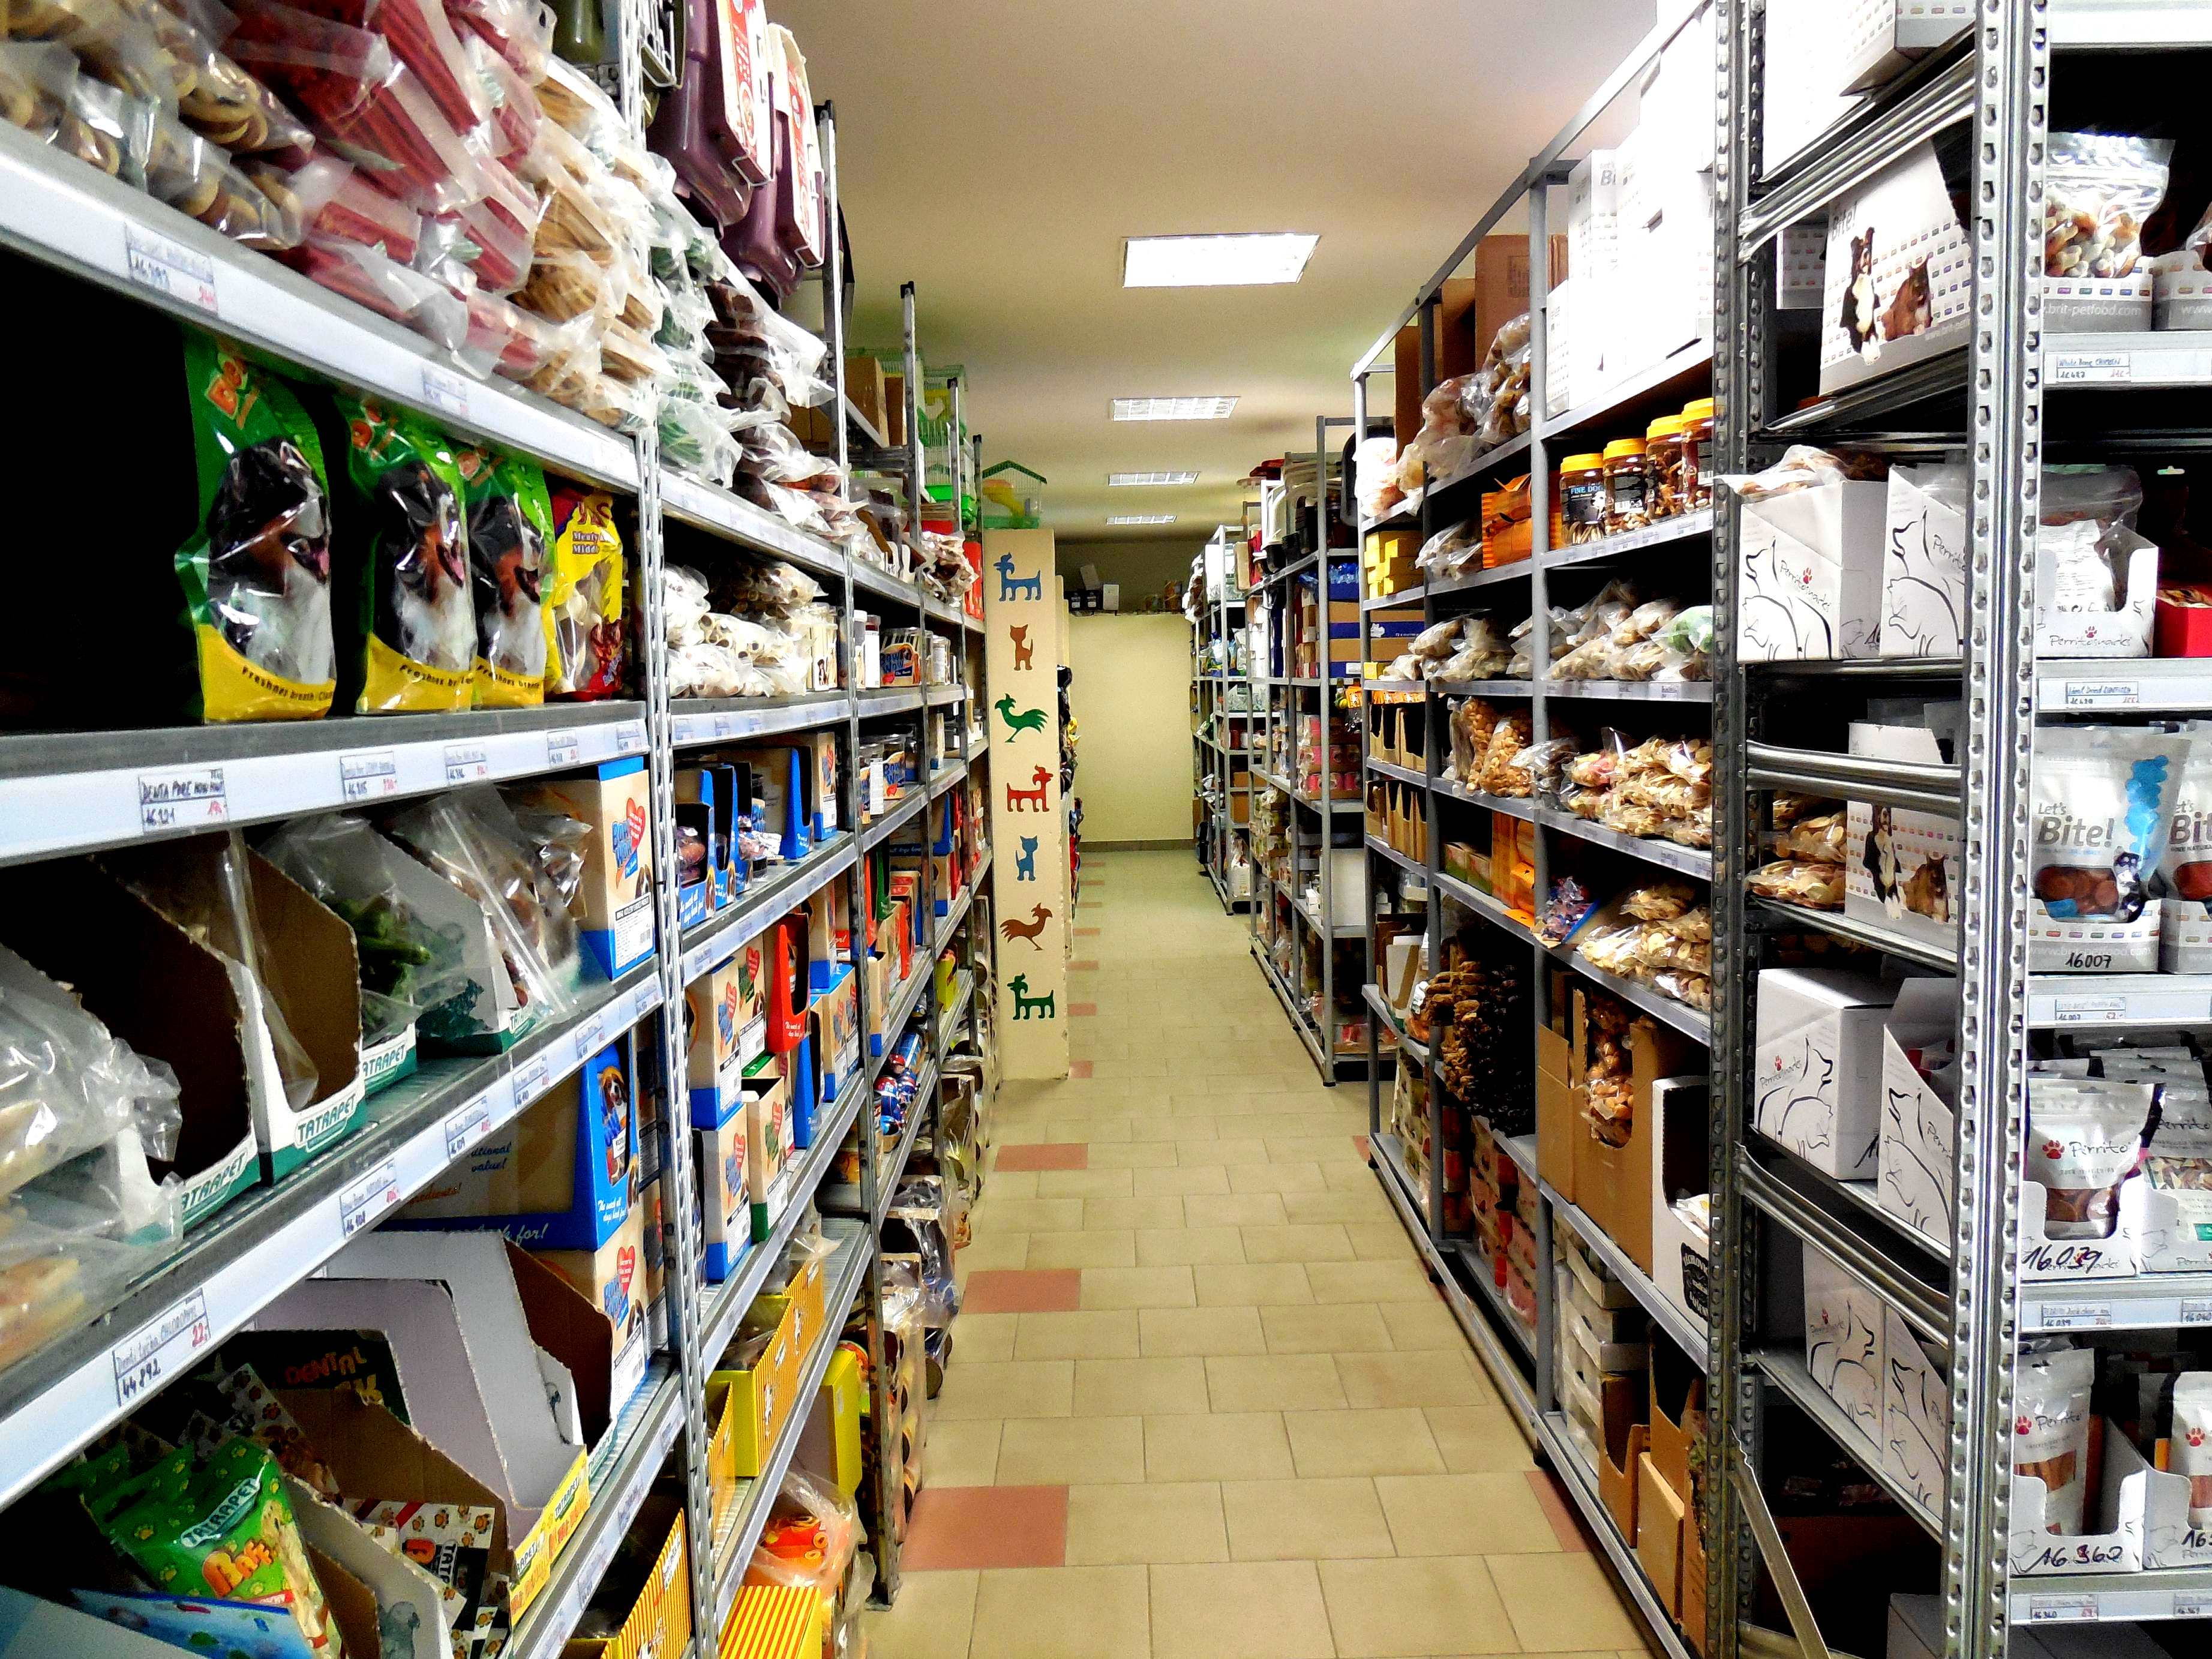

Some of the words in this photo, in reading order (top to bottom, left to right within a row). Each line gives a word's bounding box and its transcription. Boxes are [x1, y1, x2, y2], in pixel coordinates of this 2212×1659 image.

[2042, 302, 2141, 317] .brit-petfood.com
[1570, 487, 1587, 495] FINE
[573, 531, 599, 543] Meaty
[1934, 534, 1966, 571] Perrito
[2037, 802, 2067, 815] Let's
[2037, 815, 2115, 848] Bite!
[2065, 952, 2112, 969] 16007
[362, 1045, 406, 1078] ATRAPET
[298, 1093, 356, 1142] TATRAPET
[2069, 1141, 2129, 1157] Perrito
[516, 1222, 549, 1246] for!
